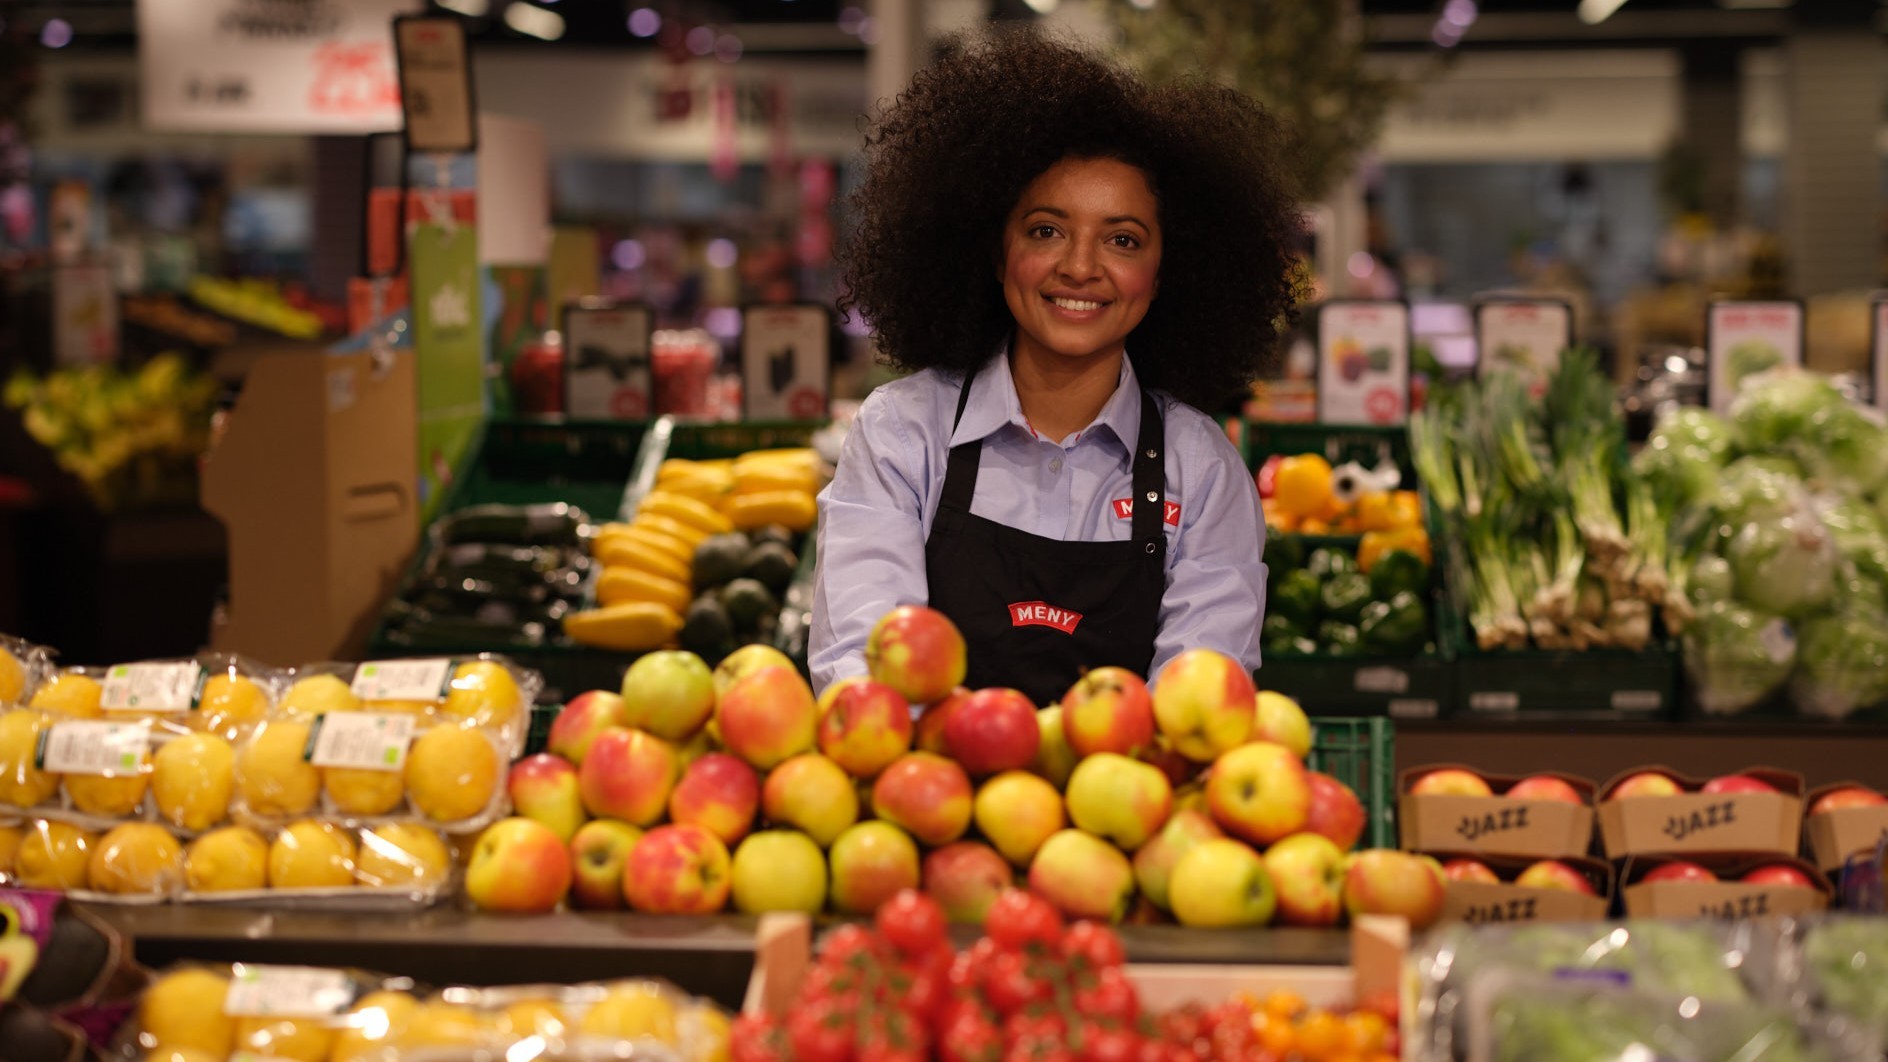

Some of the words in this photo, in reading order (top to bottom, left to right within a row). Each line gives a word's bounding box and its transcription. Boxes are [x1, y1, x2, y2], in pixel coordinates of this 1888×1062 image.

[1120, 500, 1179, 520] MY
[1016, 605, 1075, 626] MENY
[1456, 806, 1530, 841] JAZZ
[1664, 800, 1735, 841] JAZZ
